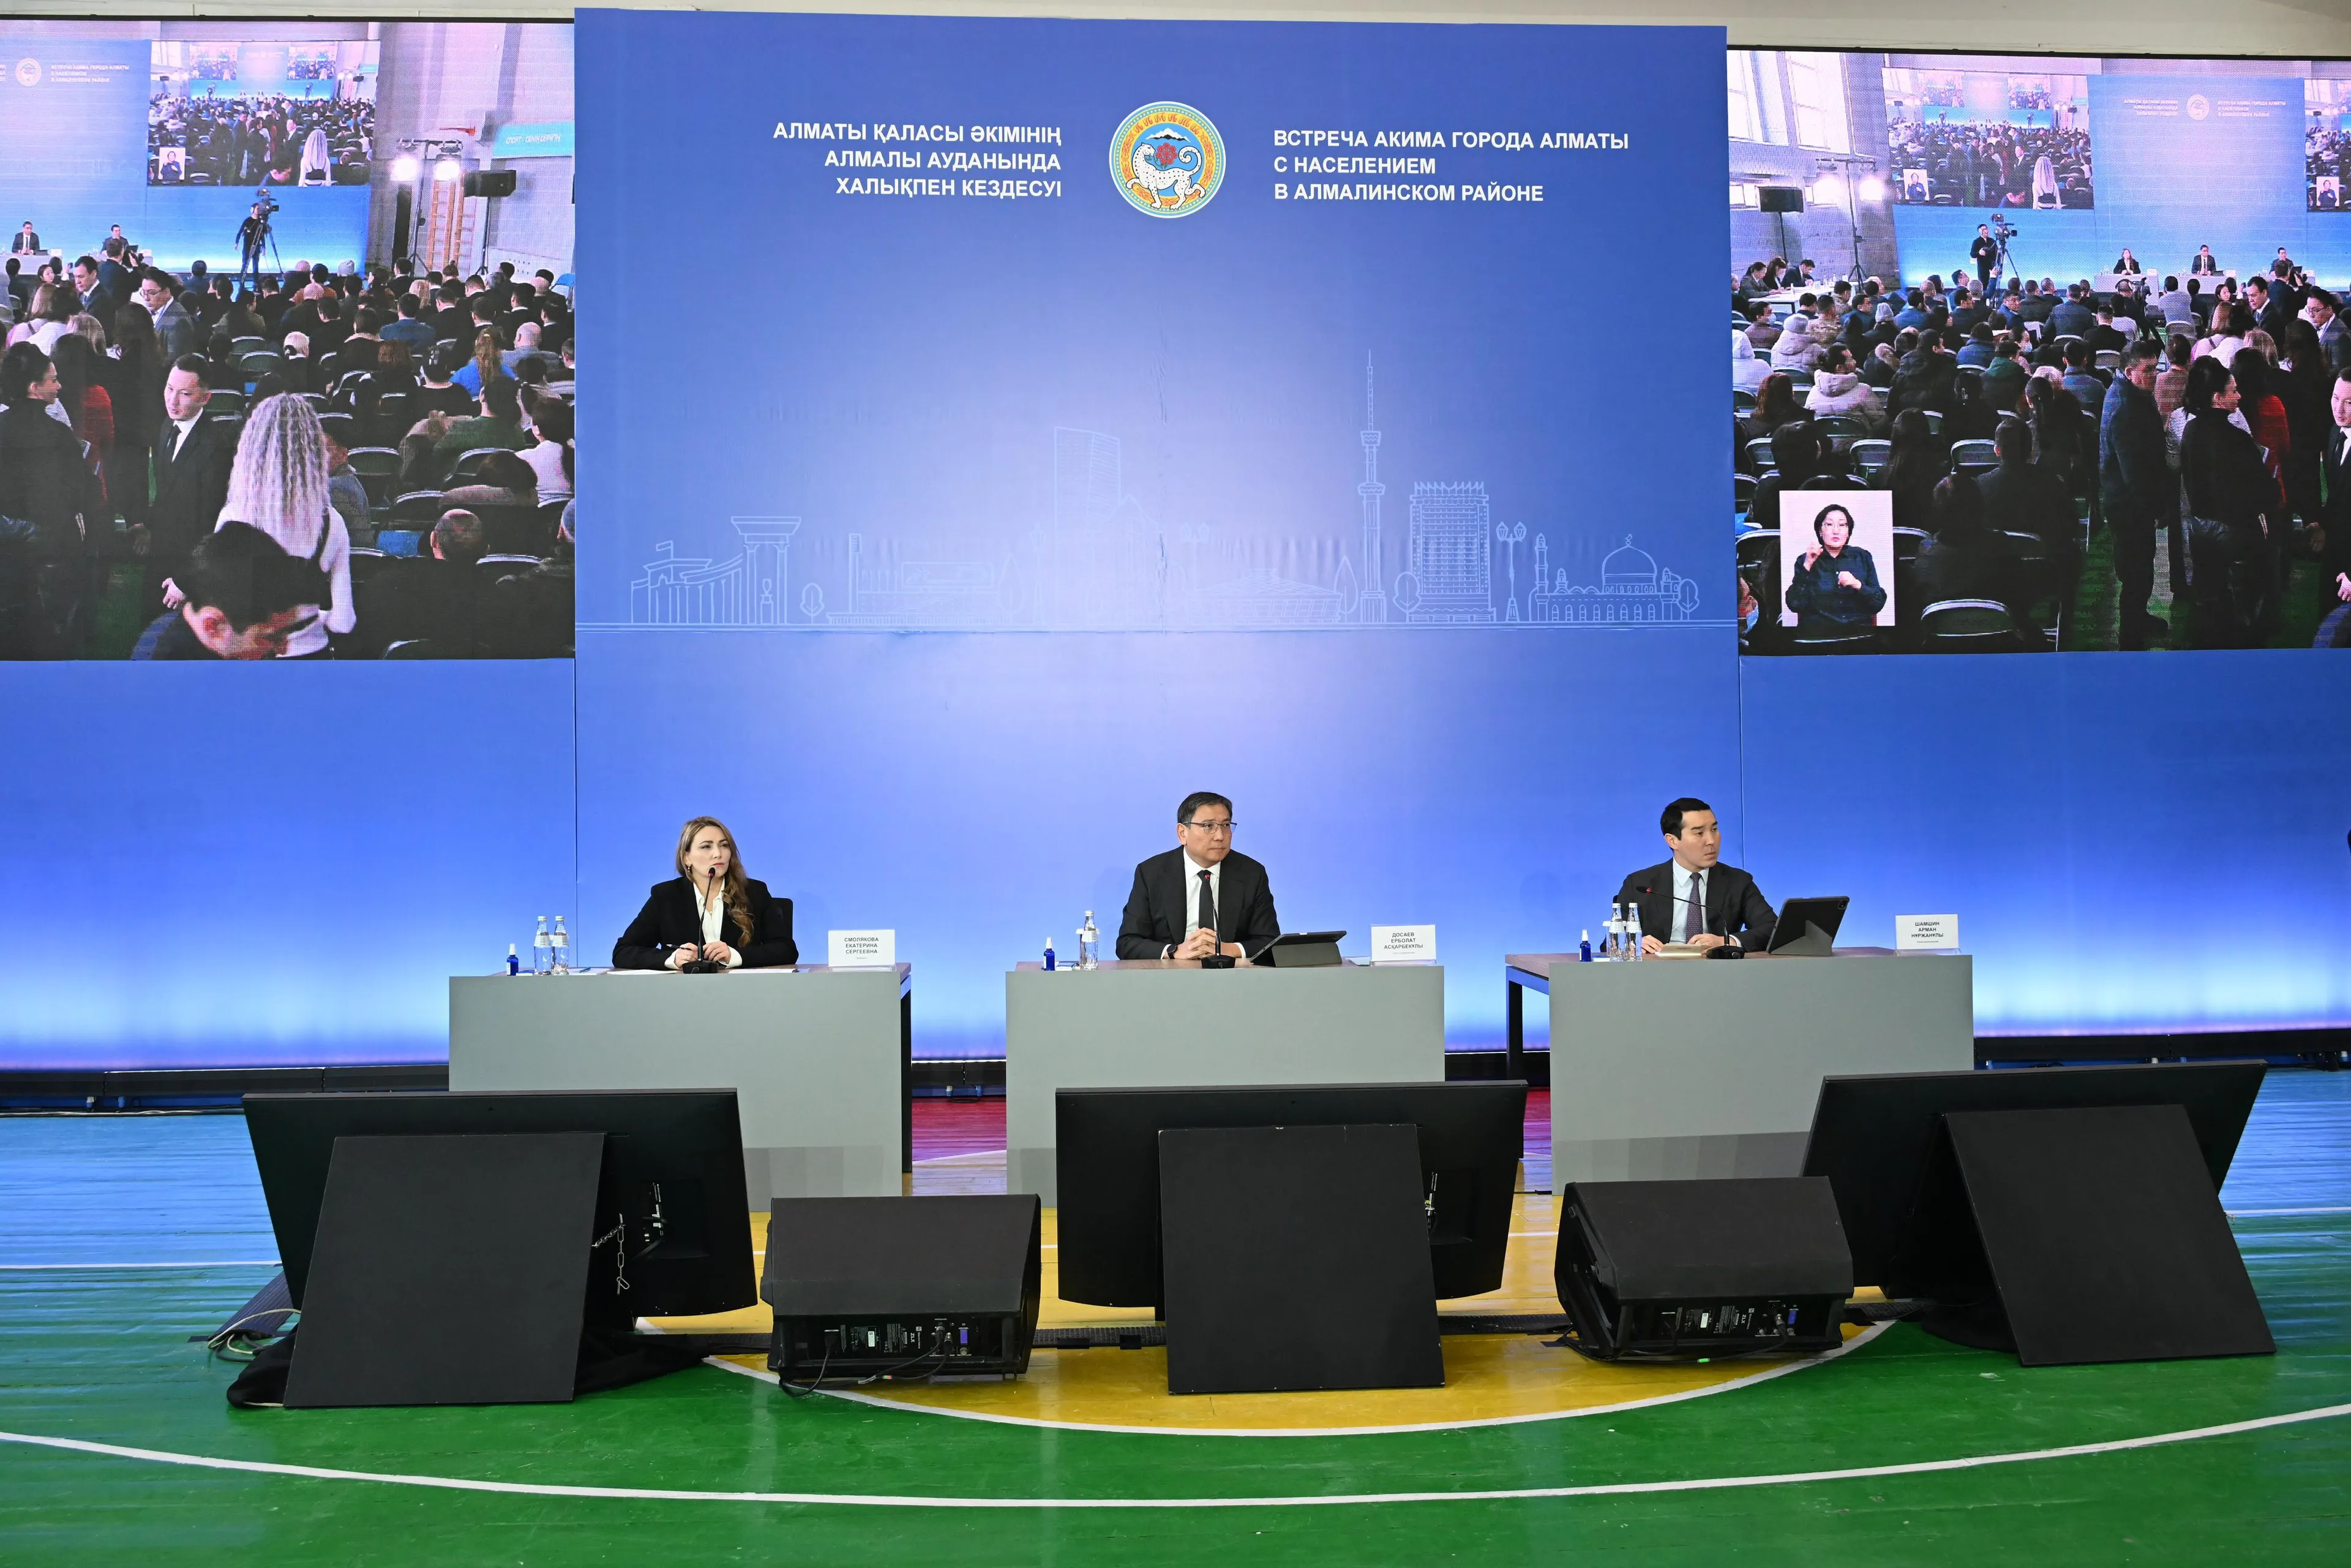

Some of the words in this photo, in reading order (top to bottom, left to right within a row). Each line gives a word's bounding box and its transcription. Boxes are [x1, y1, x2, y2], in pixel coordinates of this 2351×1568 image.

[773, 122, 866, 140] АЛМАТЫ
[874, 124, 964, 143] ҚАЛАСЫ
[970, 126, 1062, 146] ӘКІМІНІҢ
[1274, 130, 1368, 147] ВСТРЕЧА
[1374, 131, 1446, 148] АКИМА
[1452, 132, 1534, 151] ГОРОДА
[1539, 132, 1629, 149] АЛМАТЫ
[824, 150, 921, 168] АЛМАЛЫ
[927, 152, 1062, 173] АУДАНЫНДА
[1273, 156, 1288, 173] С
[1294, 156, 1436, 174] НАСЕЛЕНИЕМ
[836, 178, 955, 198] ХАЛЫҚПЕН
[962, 179, 1061, 200] КЕЗДЕСУІ
[1275, 183, 1288, 200] В
[1293, 183, 1455, 201] АЛМАЛИНСКОМ
[1461, 181, 1543, 201] РАЙОНЕ
